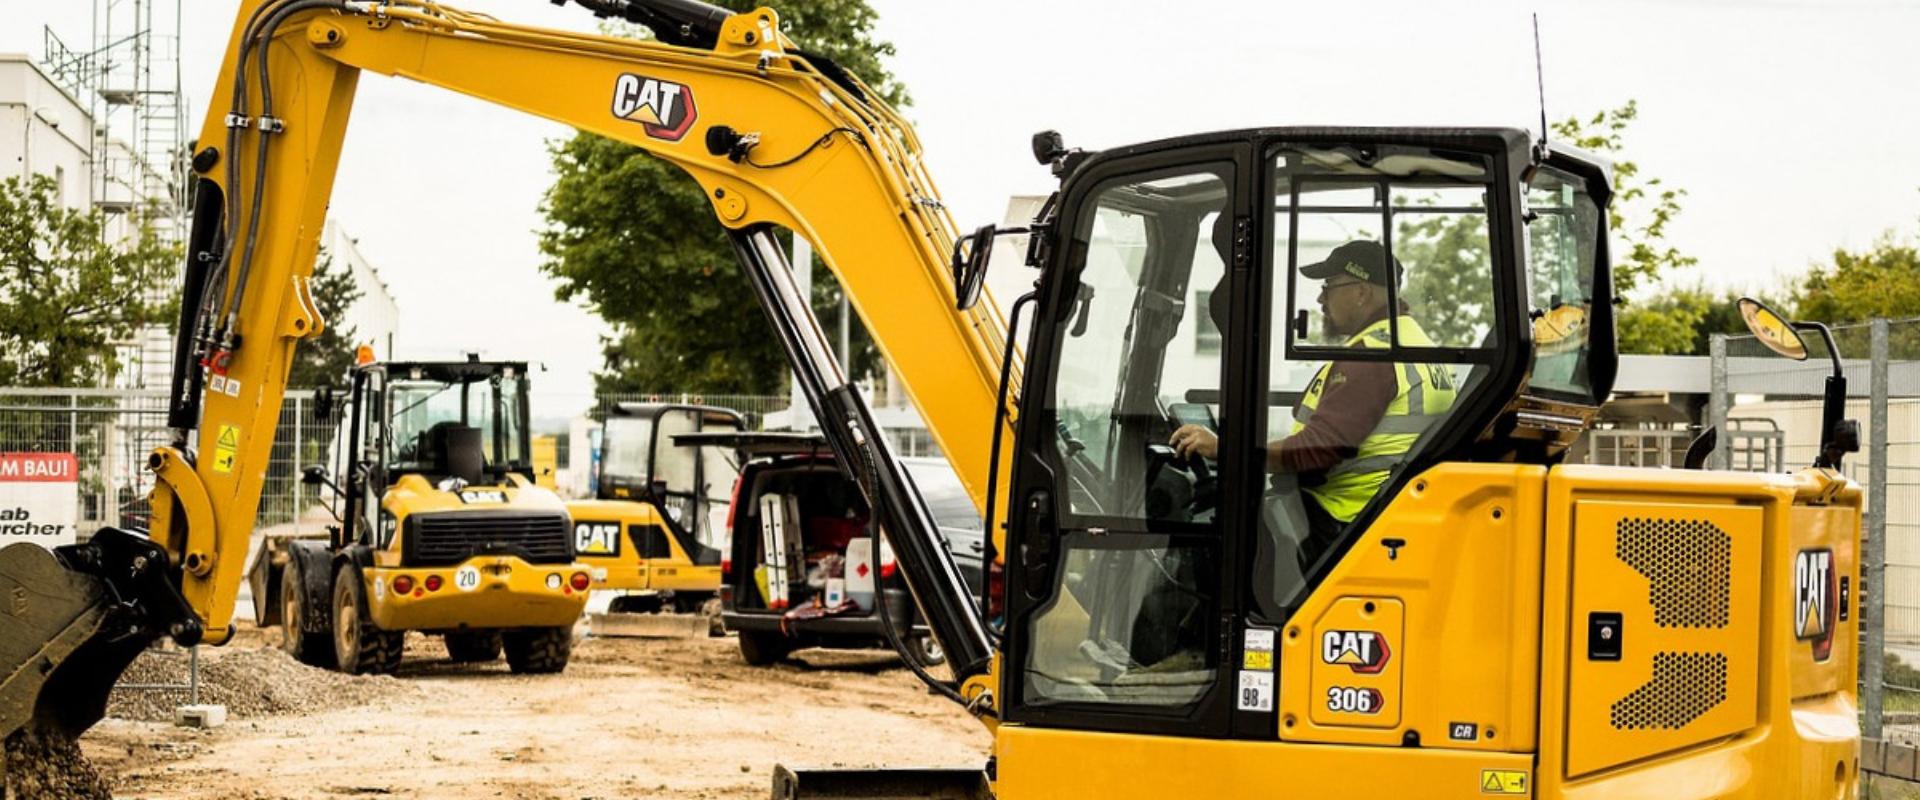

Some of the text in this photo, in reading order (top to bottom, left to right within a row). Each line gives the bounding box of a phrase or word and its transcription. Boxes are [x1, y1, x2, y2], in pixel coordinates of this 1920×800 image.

[613, 75, 680, 126] CAT
[0, 460, 68, 476] M BAU!
[0, 522, 65, 535] rcher
[575, 524, 619, 553] CAT
[459, 571, 476, 587] 20
[1796, 552, 1829, 637] CAT
[1323, 631, 1374, 665] CAT
[1242, 687, 1259, 707] 98
[1328, 687, 1371, 712] 306
[1454, 725, 1473, 738] CR
